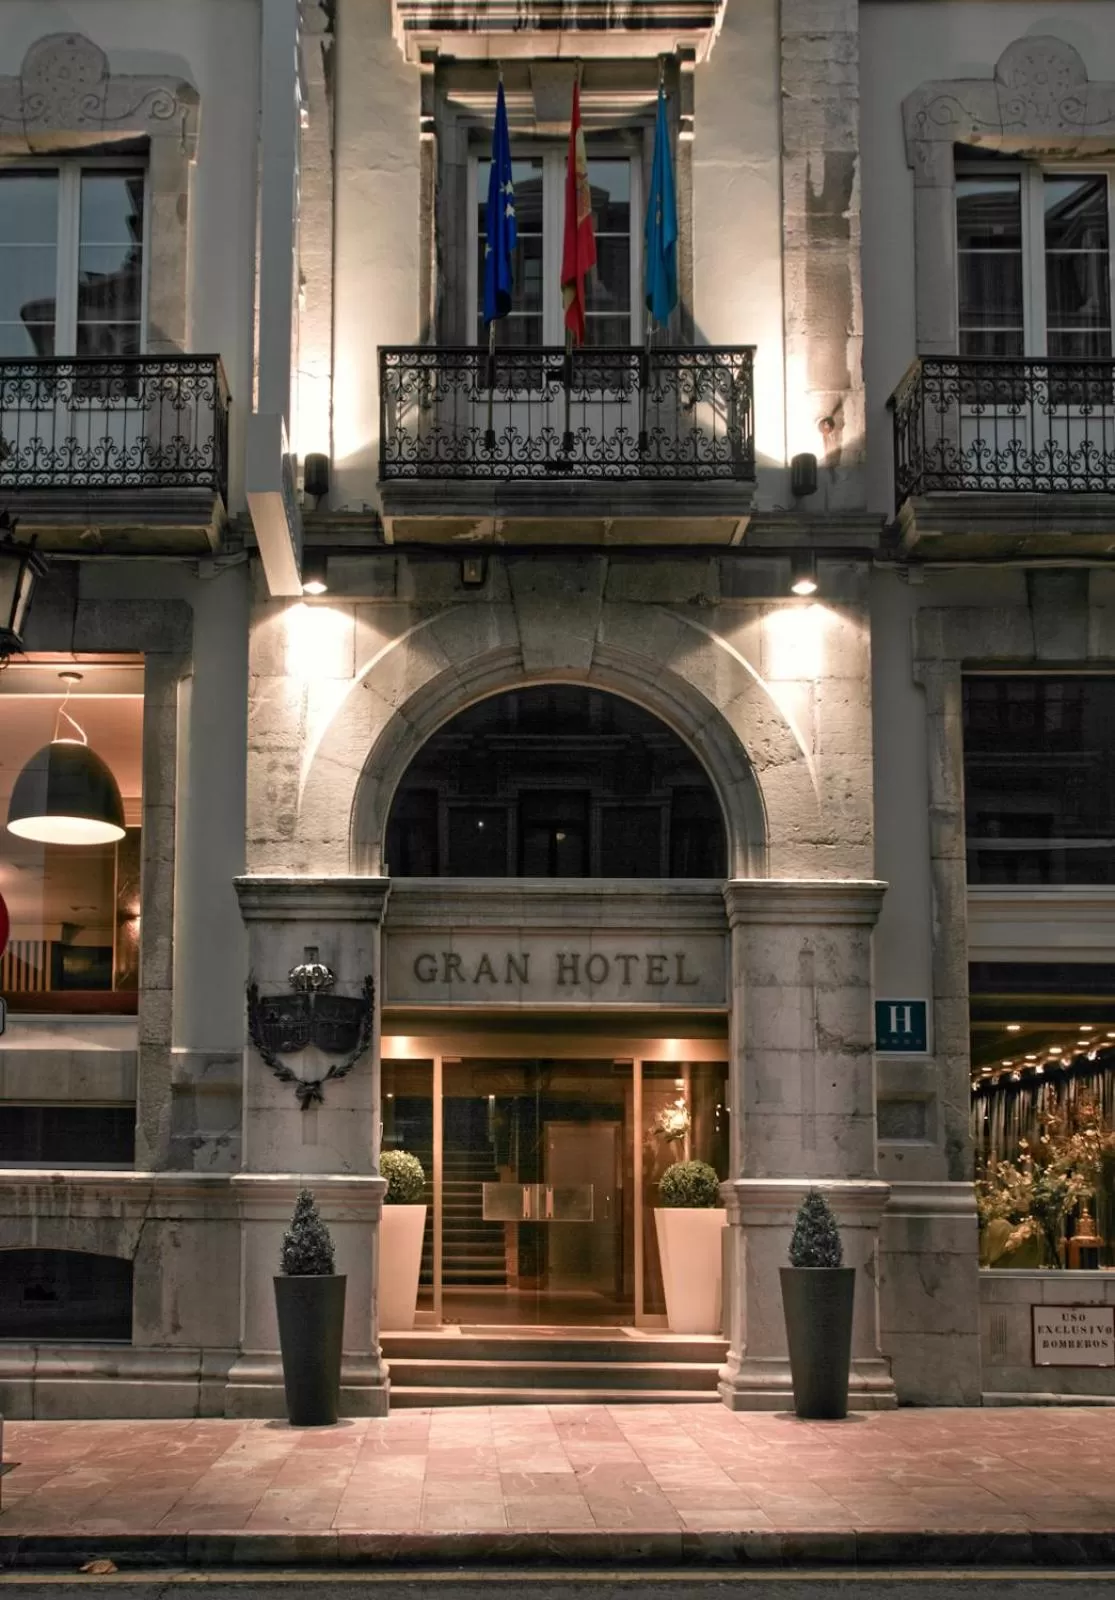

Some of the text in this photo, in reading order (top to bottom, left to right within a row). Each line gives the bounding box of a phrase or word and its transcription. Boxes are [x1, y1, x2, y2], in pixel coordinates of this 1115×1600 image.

[413, 952, 700, 985] GRAN HOTEL
[888, 1005, 912, 1033] H
[1062, 1312, 1086, 1322] USO
[1038, 1325, 1112, 1335] EXCLUSIVO
[1042, 1339, 1108, 1349] BOMBEROS
